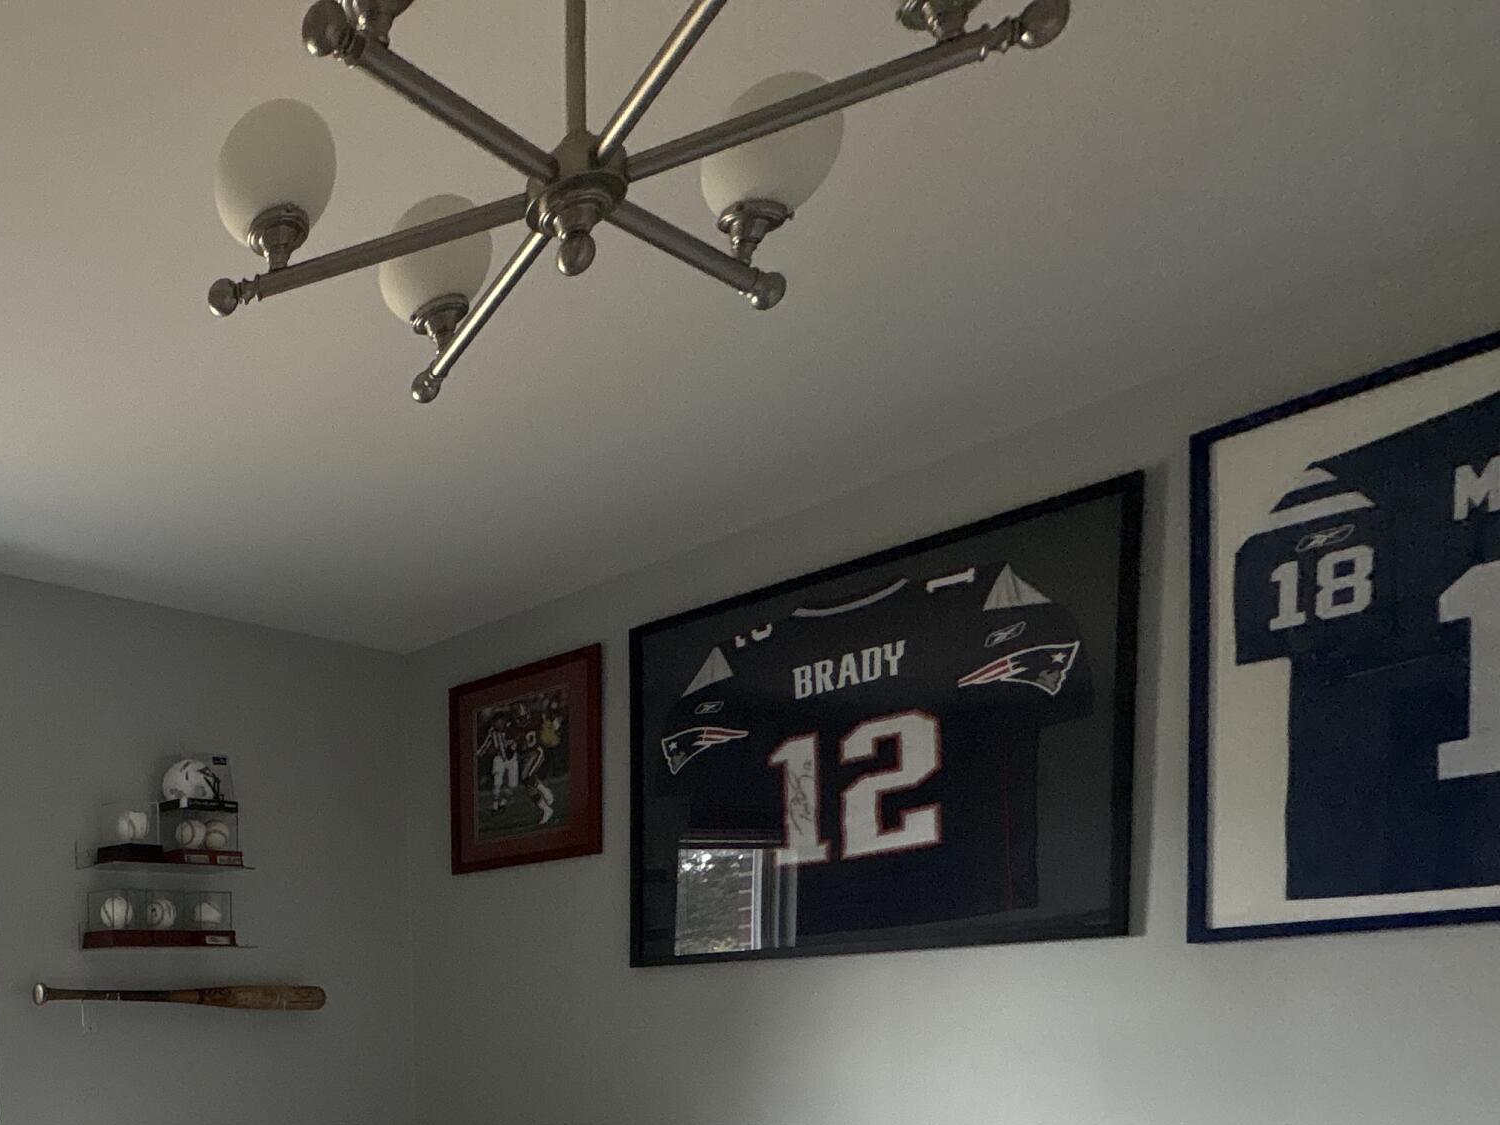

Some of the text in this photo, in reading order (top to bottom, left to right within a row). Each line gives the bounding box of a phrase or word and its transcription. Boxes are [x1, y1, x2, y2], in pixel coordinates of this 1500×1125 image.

[1269, 545, 1374, 632] 18
[793, 639, 906, 699] BRADY
[769, 710, 942, 866] 12
